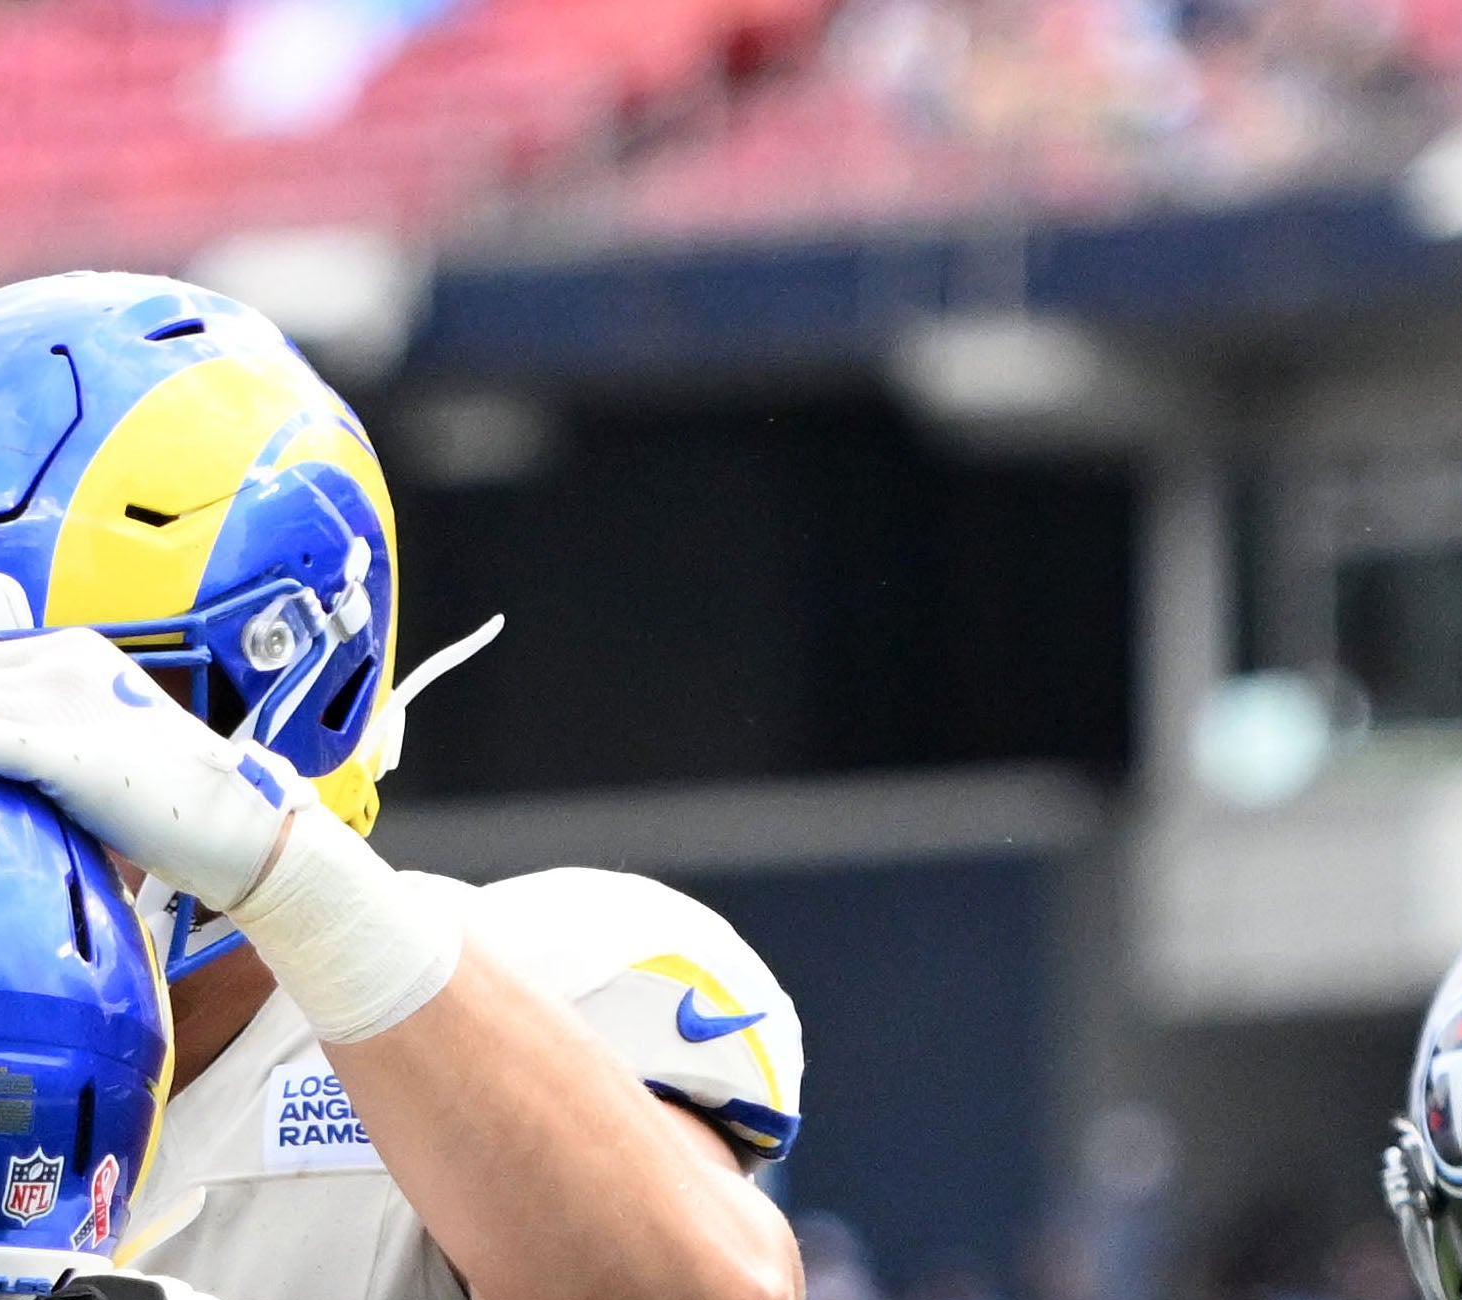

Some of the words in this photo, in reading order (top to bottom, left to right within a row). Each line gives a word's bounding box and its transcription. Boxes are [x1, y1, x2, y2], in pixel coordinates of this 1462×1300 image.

[282, 1074, 343, 1099] LOS
[279, 1122, 371, 1148] RAMS
[9, 1184, 49, 1214] NFL
